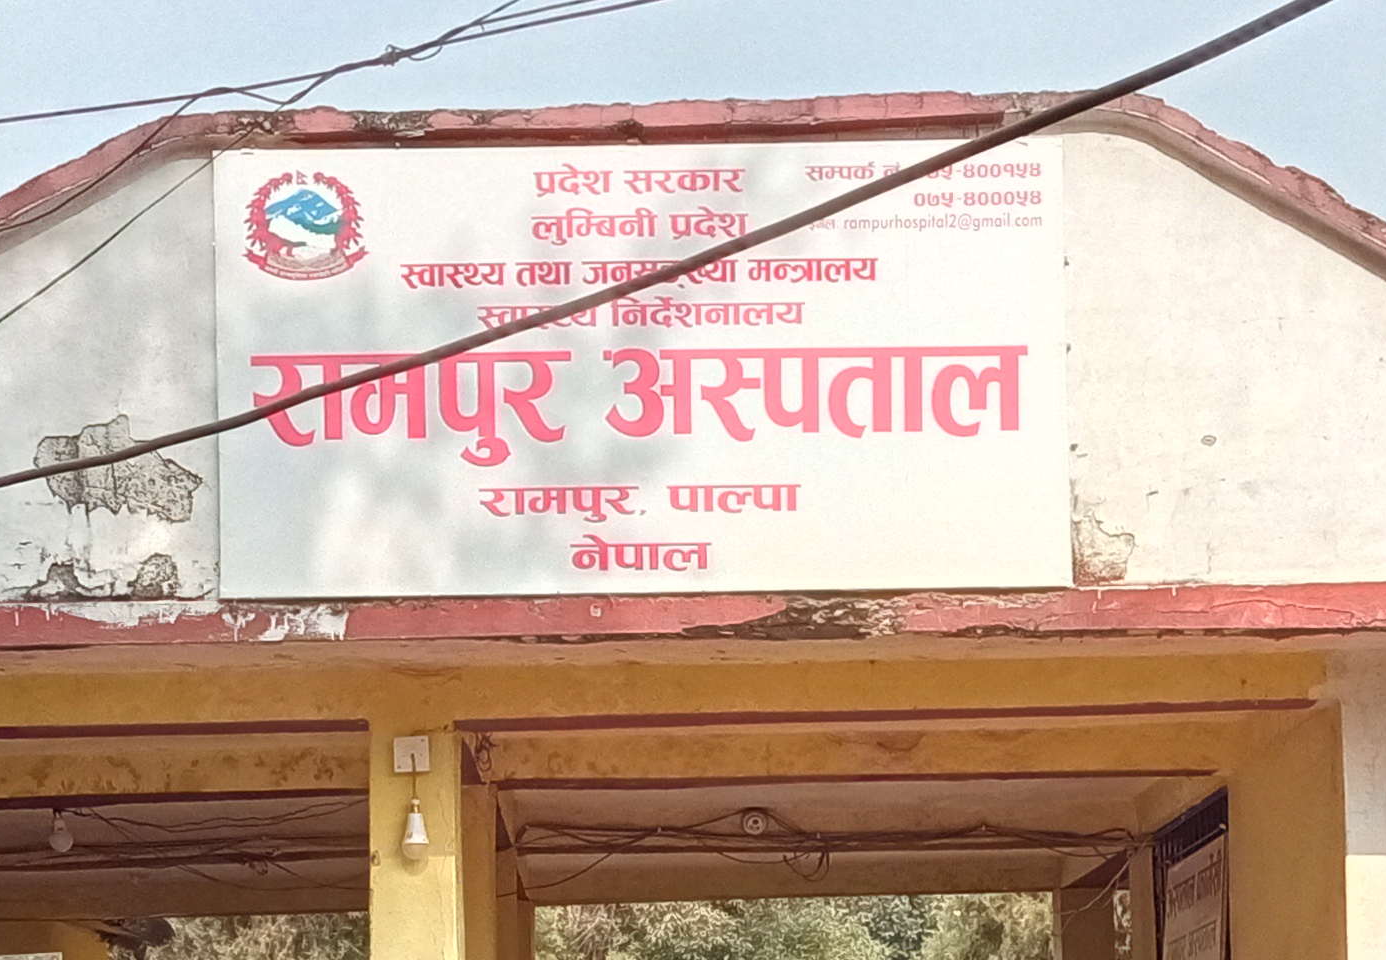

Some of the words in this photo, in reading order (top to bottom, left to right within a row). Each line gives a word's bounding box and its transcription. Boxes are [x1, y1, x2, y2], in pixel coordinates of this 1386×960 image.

[533, 163, 613, 197] प्रदेश
[623, 169, 746, 194] सरकार
[804, 161, 876, 181] सम्पर्क
[913, 190, 1042, 208] ०७५-४०००५४
[531, 207, 658, 246] लुम्बिनी
[668, 206, 749, 240] प्रदेश
[843, 213, 1043, 232] rampurhospital2@gmail.com
[401, 263, 506, 289] स्वास्थ्य
[516, 261, 571, 284] तथा
[747, 257, 879, 284] मन्त्रालय
[611, 296, 804, 329] निर्देशनालय
[251, 349, 573, 467] रामपुर
[603, 345, 1028, 443] अस्पताल
[479, 486, 647, 523] रामपुर,
[666, 484, 801, 514] पाल्पा
[570, 534, 712, 571] नेपाल
